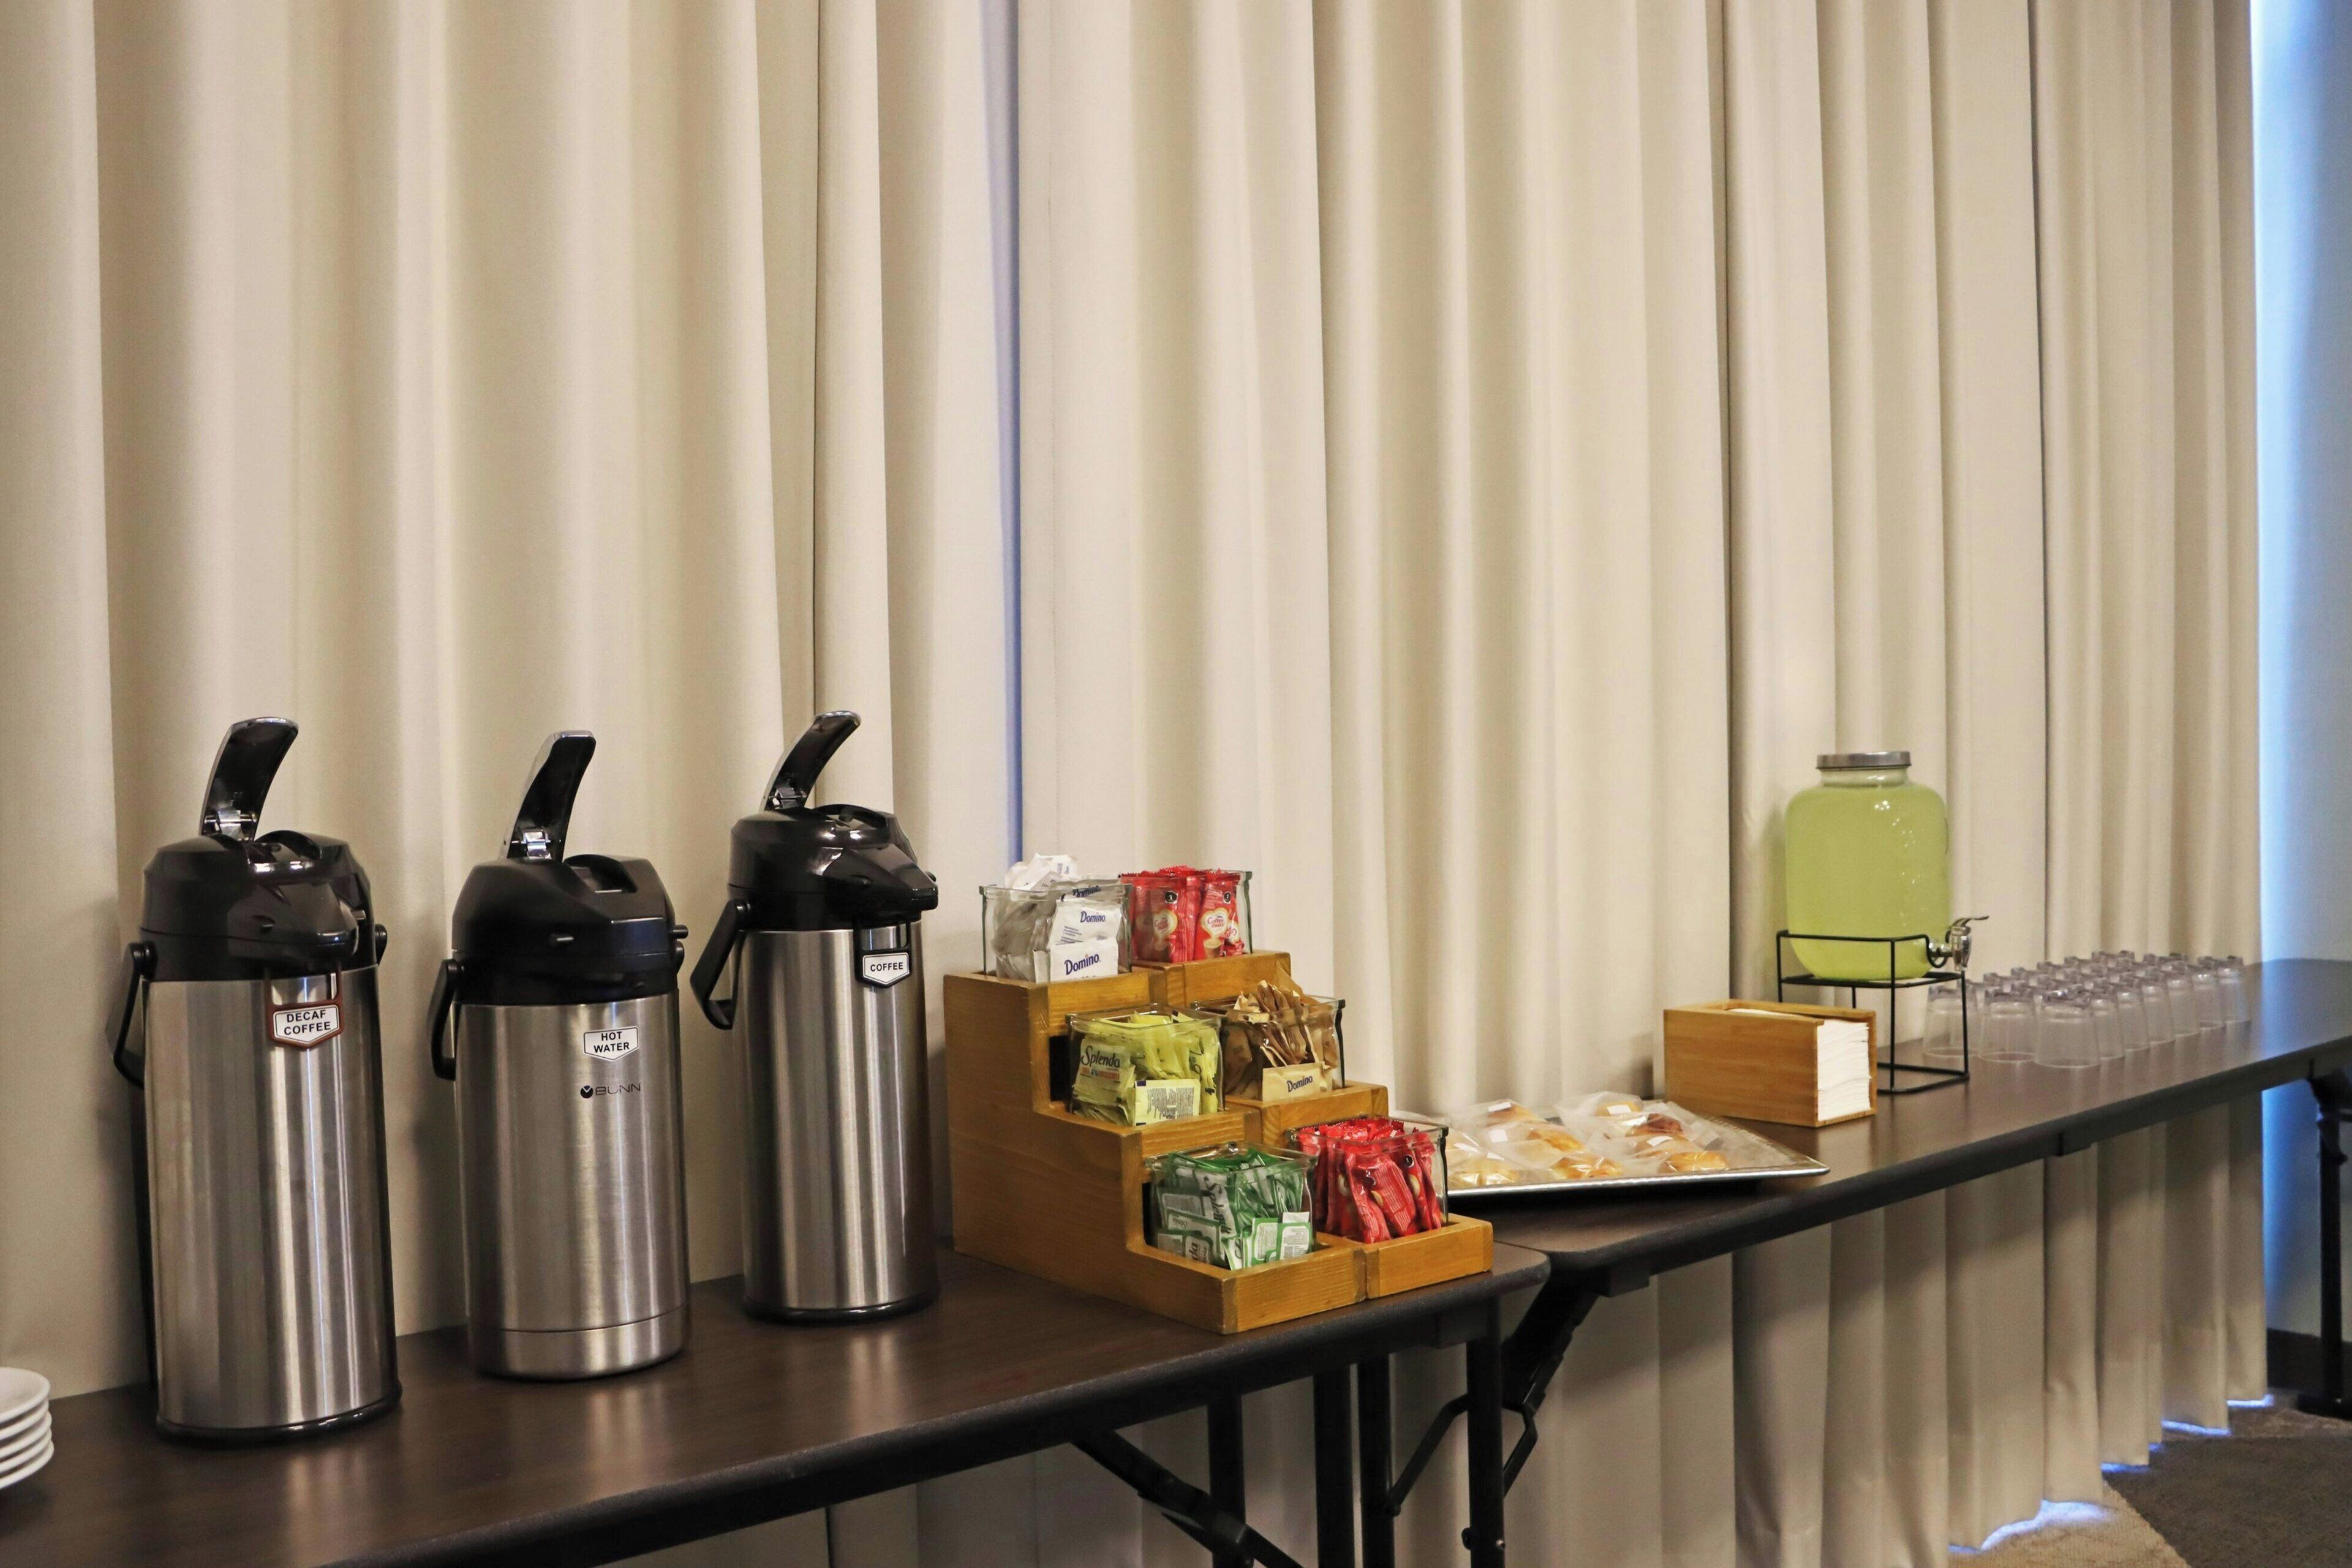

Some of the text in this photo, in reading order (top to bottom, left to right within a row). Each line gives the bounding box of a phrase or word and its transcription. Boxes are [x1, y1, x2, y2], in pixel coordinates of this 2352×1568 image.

[1080, 911, 1106, 923] Domino
[870, 962, 903, 972] COFFEE
[1064, 953, 1100, 975] Domino
[287, 1009, 326, 1023] DECAF
[284, 1021, 331, 1035] COFFEE
[601, 1031, 622, 1041] HOT
[594, 1042, 630, 1053] WATER
[1080, 1045, 1120, 1068] Splenda
[595, 1083, 641, 1096] BUNN
[1286, 1076, 1313, 1093] Domino
